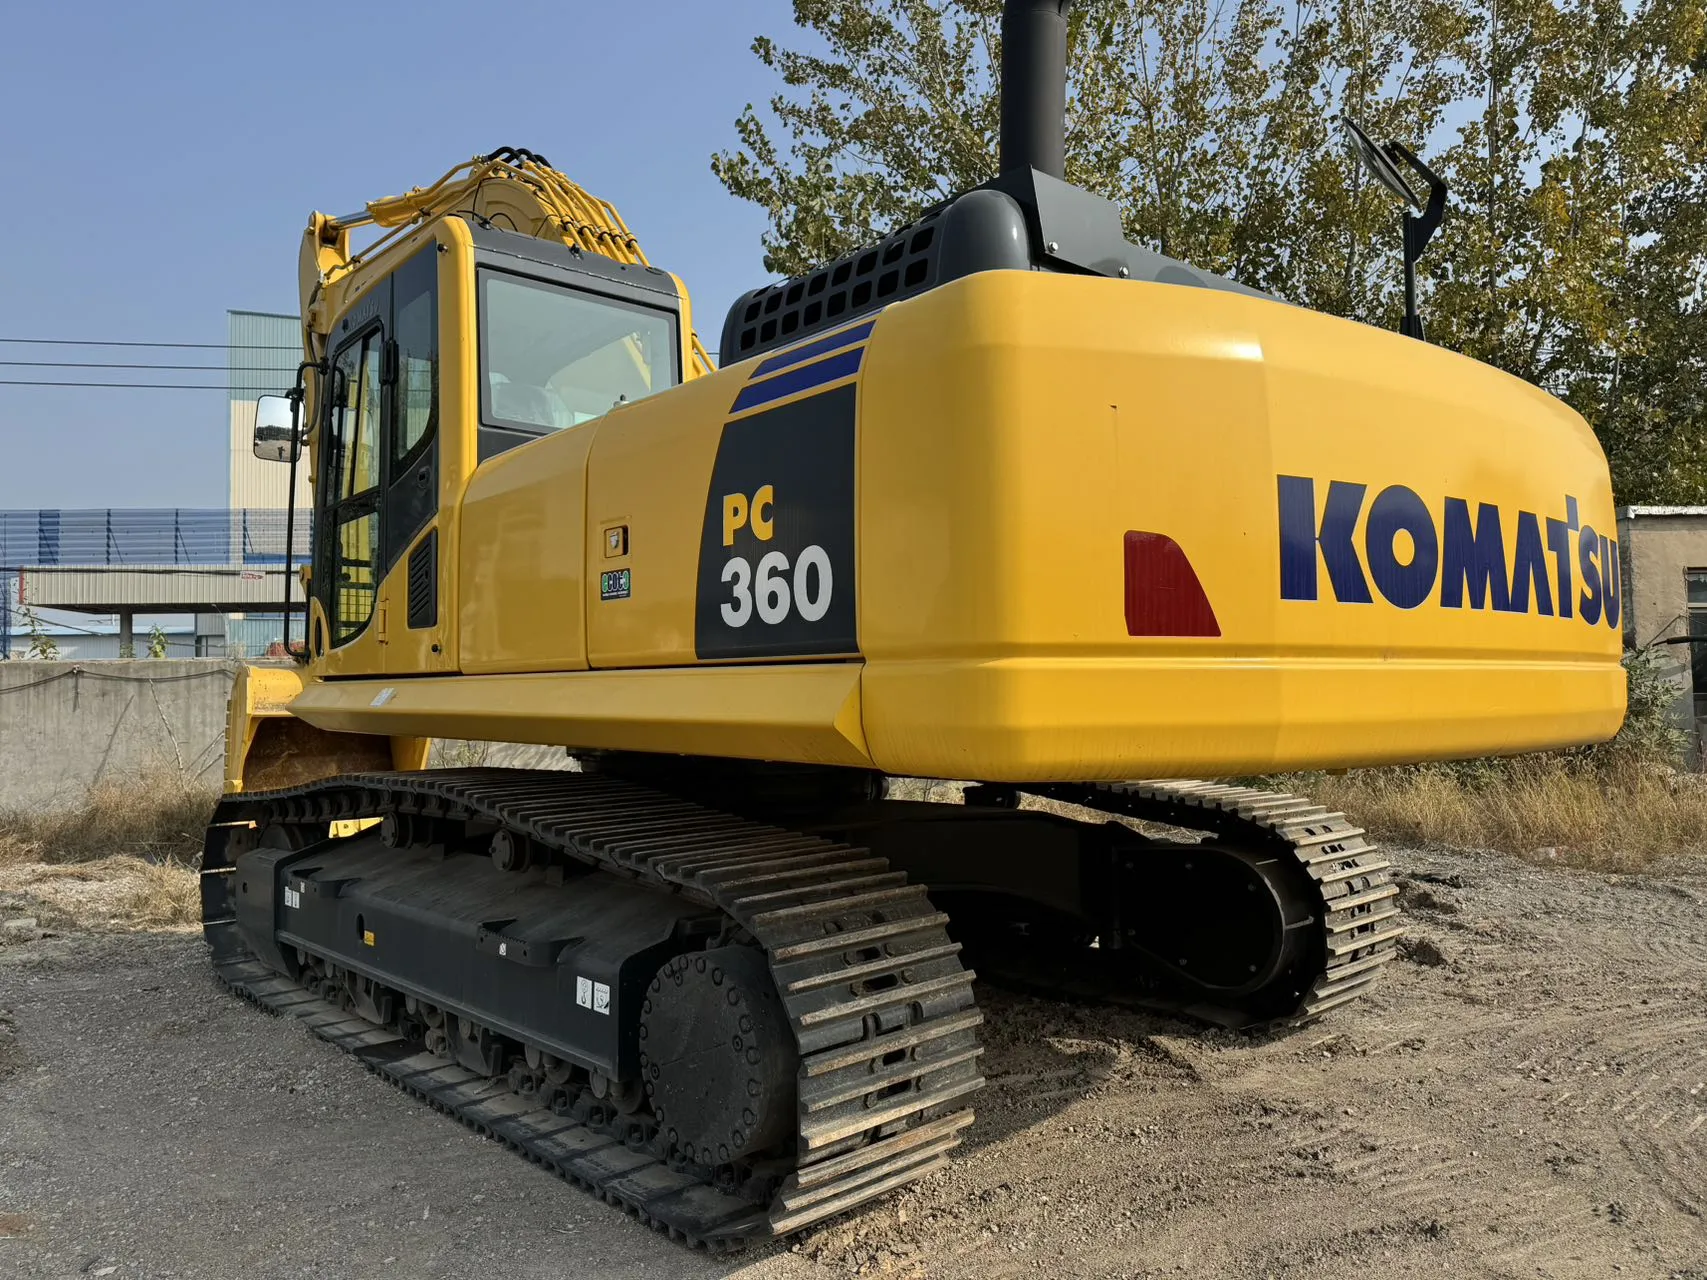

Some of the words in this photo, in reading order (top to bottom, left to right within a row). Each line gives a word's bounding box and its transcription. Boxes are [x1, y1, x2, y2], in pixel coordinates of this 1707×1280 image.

[723, 484, 774, 547] PC
[1276, 474, 1621, 629] KOMATSU
[720, 544, 833, 628] 360
